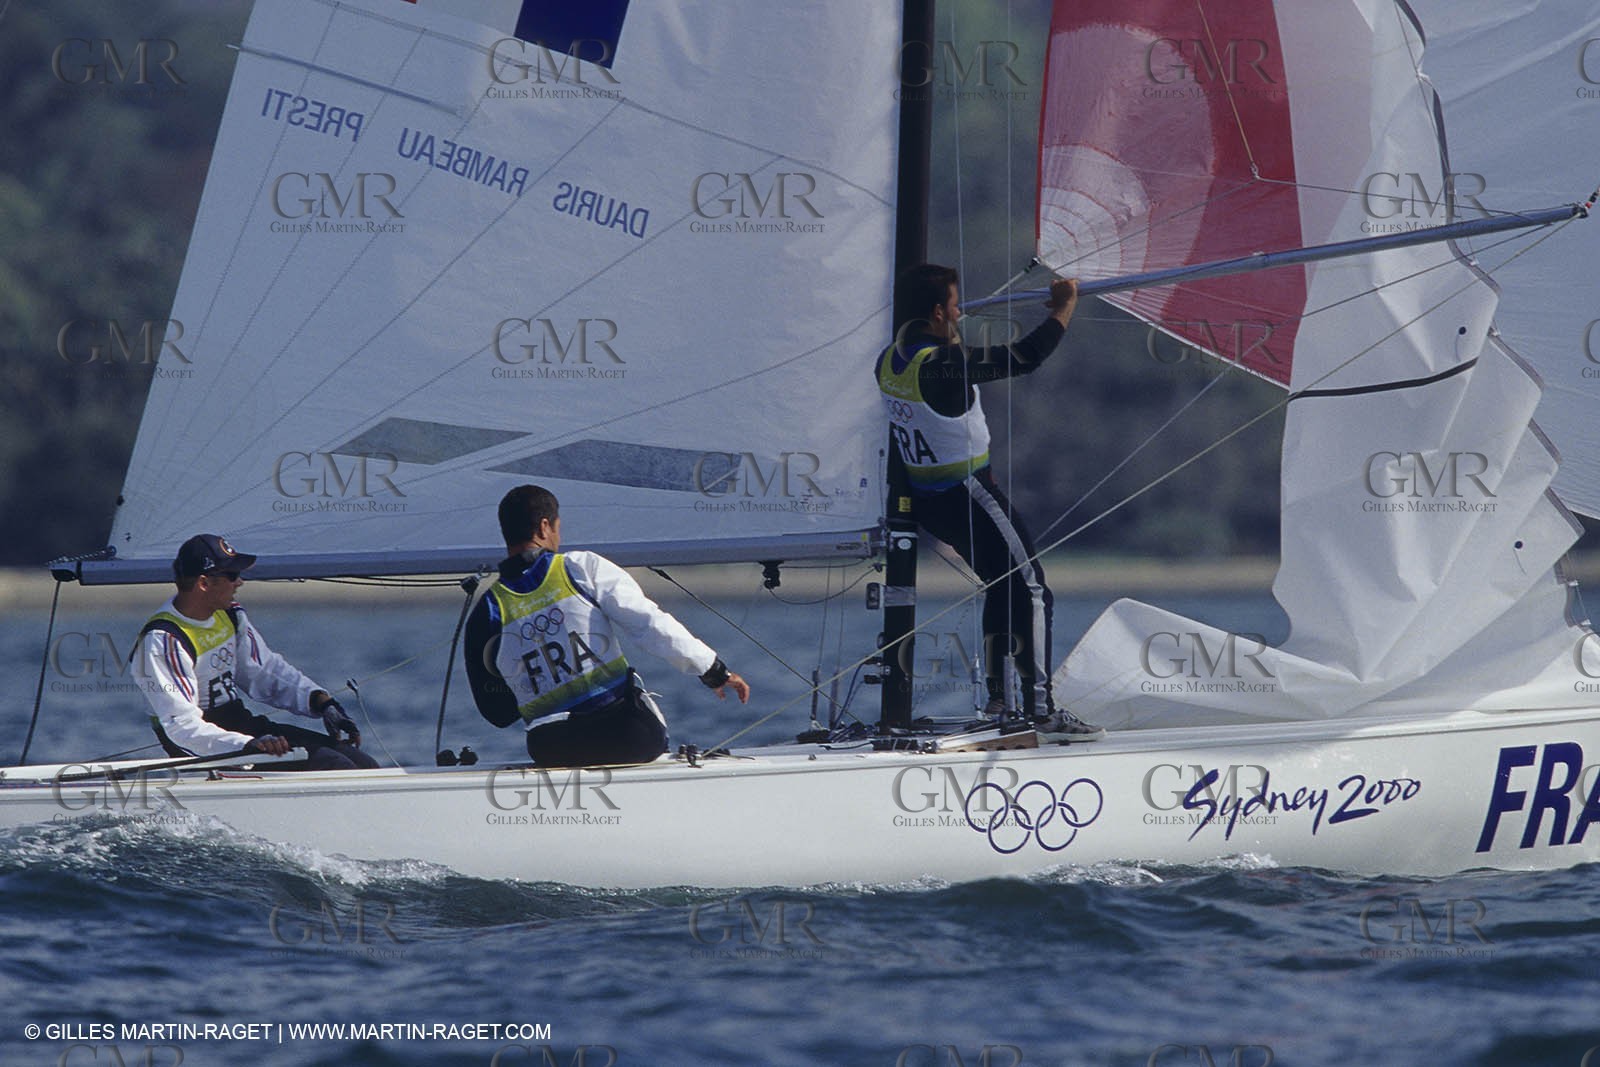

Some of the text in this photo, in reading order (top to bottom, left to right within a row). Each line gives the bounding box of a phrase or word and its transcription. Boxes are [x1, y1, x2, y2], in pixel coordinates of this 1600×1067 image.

[522, 630, 602, 695] FRA
[1182, 769, 1421, 841] Sydney 2000
[1475, 741, 1600, 853] FRA
